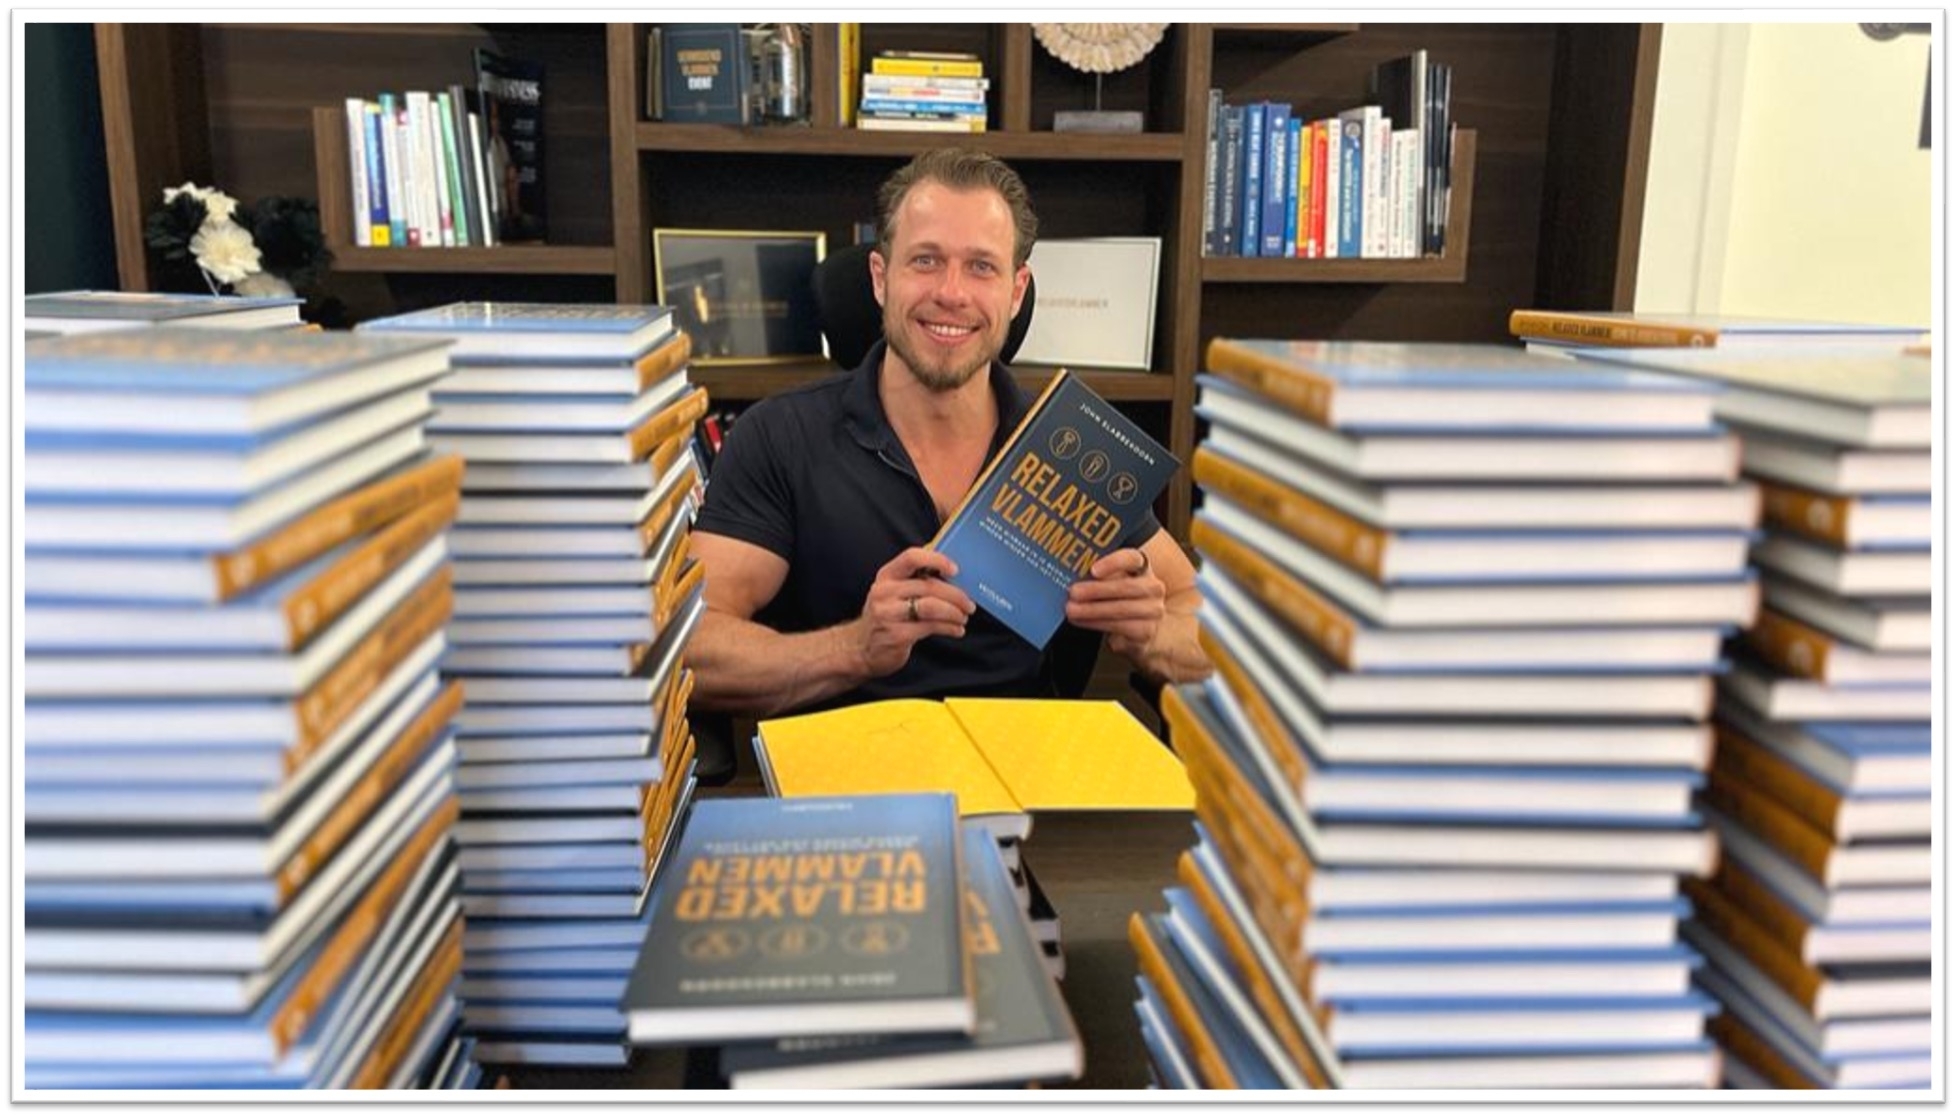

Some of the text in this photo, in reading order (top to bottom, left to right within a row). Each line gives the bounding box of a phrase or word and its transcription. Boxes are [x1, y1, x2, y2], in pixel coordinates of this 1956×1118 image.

[1079, 403, 1101, 422] JOHN
[1010, 452, 1122, 548] RELAXED
[989, 483, 1101, 579] VLAMMEN
[687, 850, 928, 888] VLAMMEN
[674, 877, 928, 922] RELAXED
